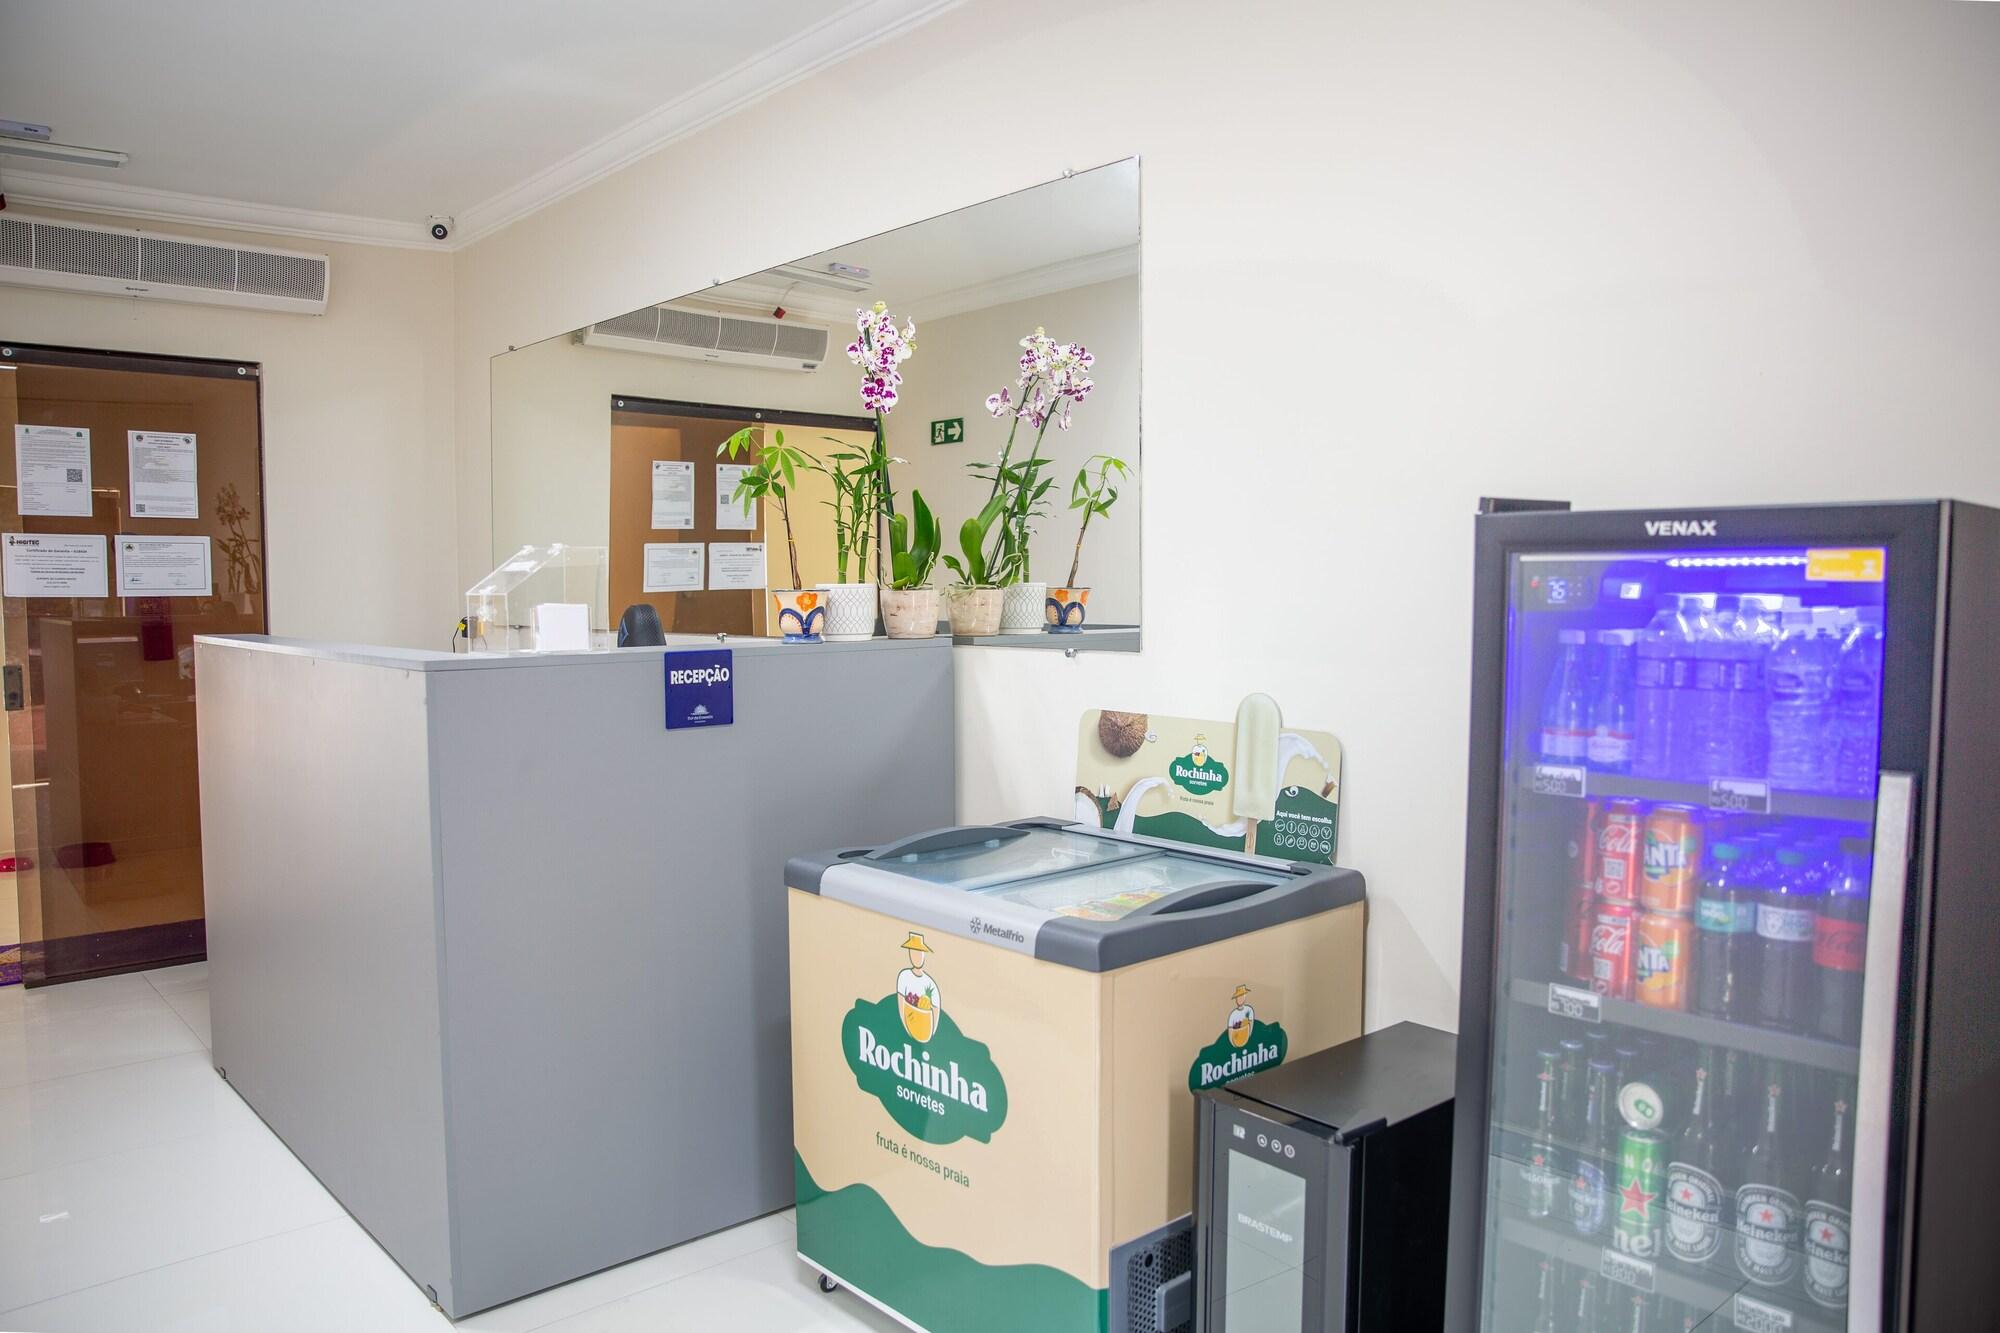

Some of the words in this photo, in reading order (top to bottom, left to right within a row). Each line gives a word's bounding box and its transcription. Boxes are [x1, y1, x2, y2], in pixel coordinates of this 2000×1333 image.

[1645, 520, 1717, 536] VENAX
[670, 664, 730, 687] RECEPÇÃO
[1175, 764, 1223, 782] Rochinha
[983, 922, 1025, 943] Metalfrio
[858, 1025, 988, 1112] Rochinha
[1200, 1042, 1279, 1086] Rochinha
[896, 1084, 945, 1115] sorvetes
[876, 1131, 899, 1155] fruta
[901, 1143, 908, 1158] é
[910, 1149, 941, 1175] nossa
[943, 1165, 970, 1188] praia
[1238, 1213, 1293, 1243] BRASTEMP
